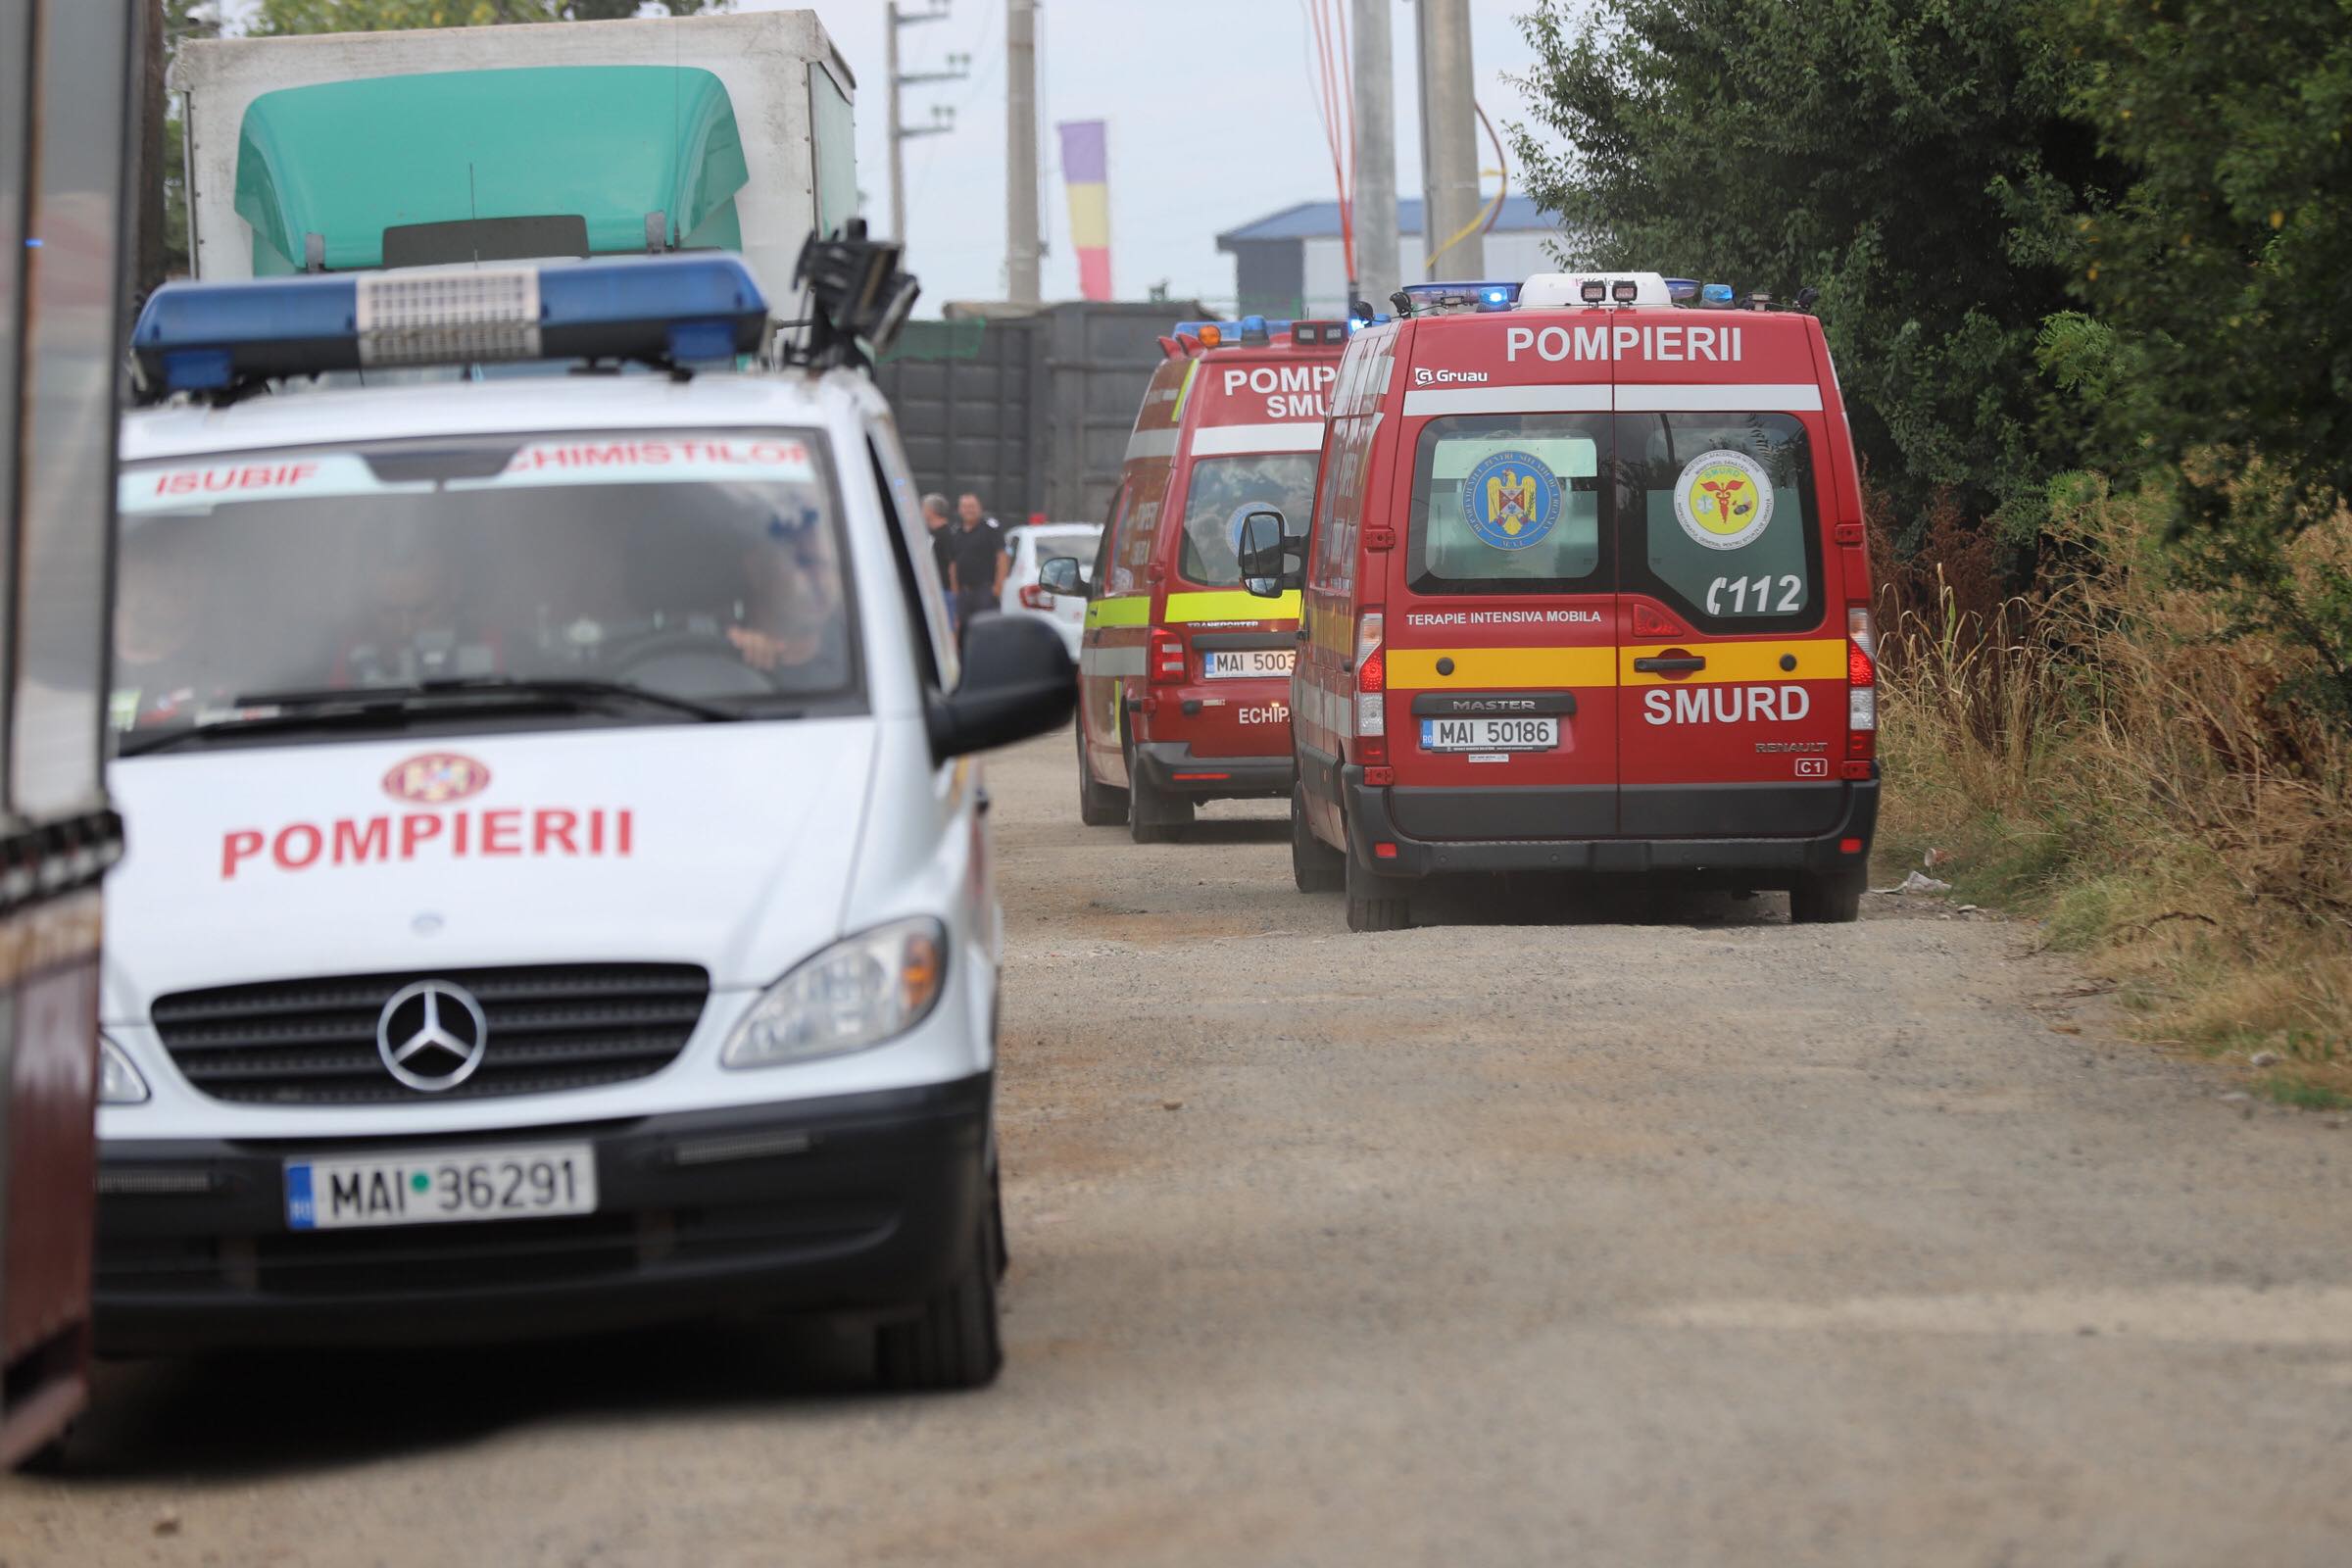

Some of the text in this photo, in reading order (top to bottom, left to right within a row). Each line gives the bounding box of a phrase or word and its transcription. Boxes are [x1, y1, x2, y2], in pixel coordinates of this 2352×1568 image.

[1507, 325, 1741, 363] POMPIERII
[1436, 369, 1488, 382] Gruau
[155, 464, 318, 496] ISUBIF
[1728, 574, 1801, 612] 112
[1406, 611, 1601, 625] TERAPIE INTENSIVA MOBILA
[1217, 654, 1245, 672] MAI
[1239, 707, 1291, 724] ECHIP
[1453, 701, 1536, 710] MASTER
[1642, 686, 1810, 726] SMURD
[1440, 722, 1474, 744] MAI
[1487, 721, 1549, 744] 50186
[1755, 742, 1828, 753] RENAULT
[1800, 761, 1821, 773] C1
[220, 809, 635, 880] POMPIERII
[331, 1169, 405, 1218] MAI
[439, 1160, 575, 1212] 36291
